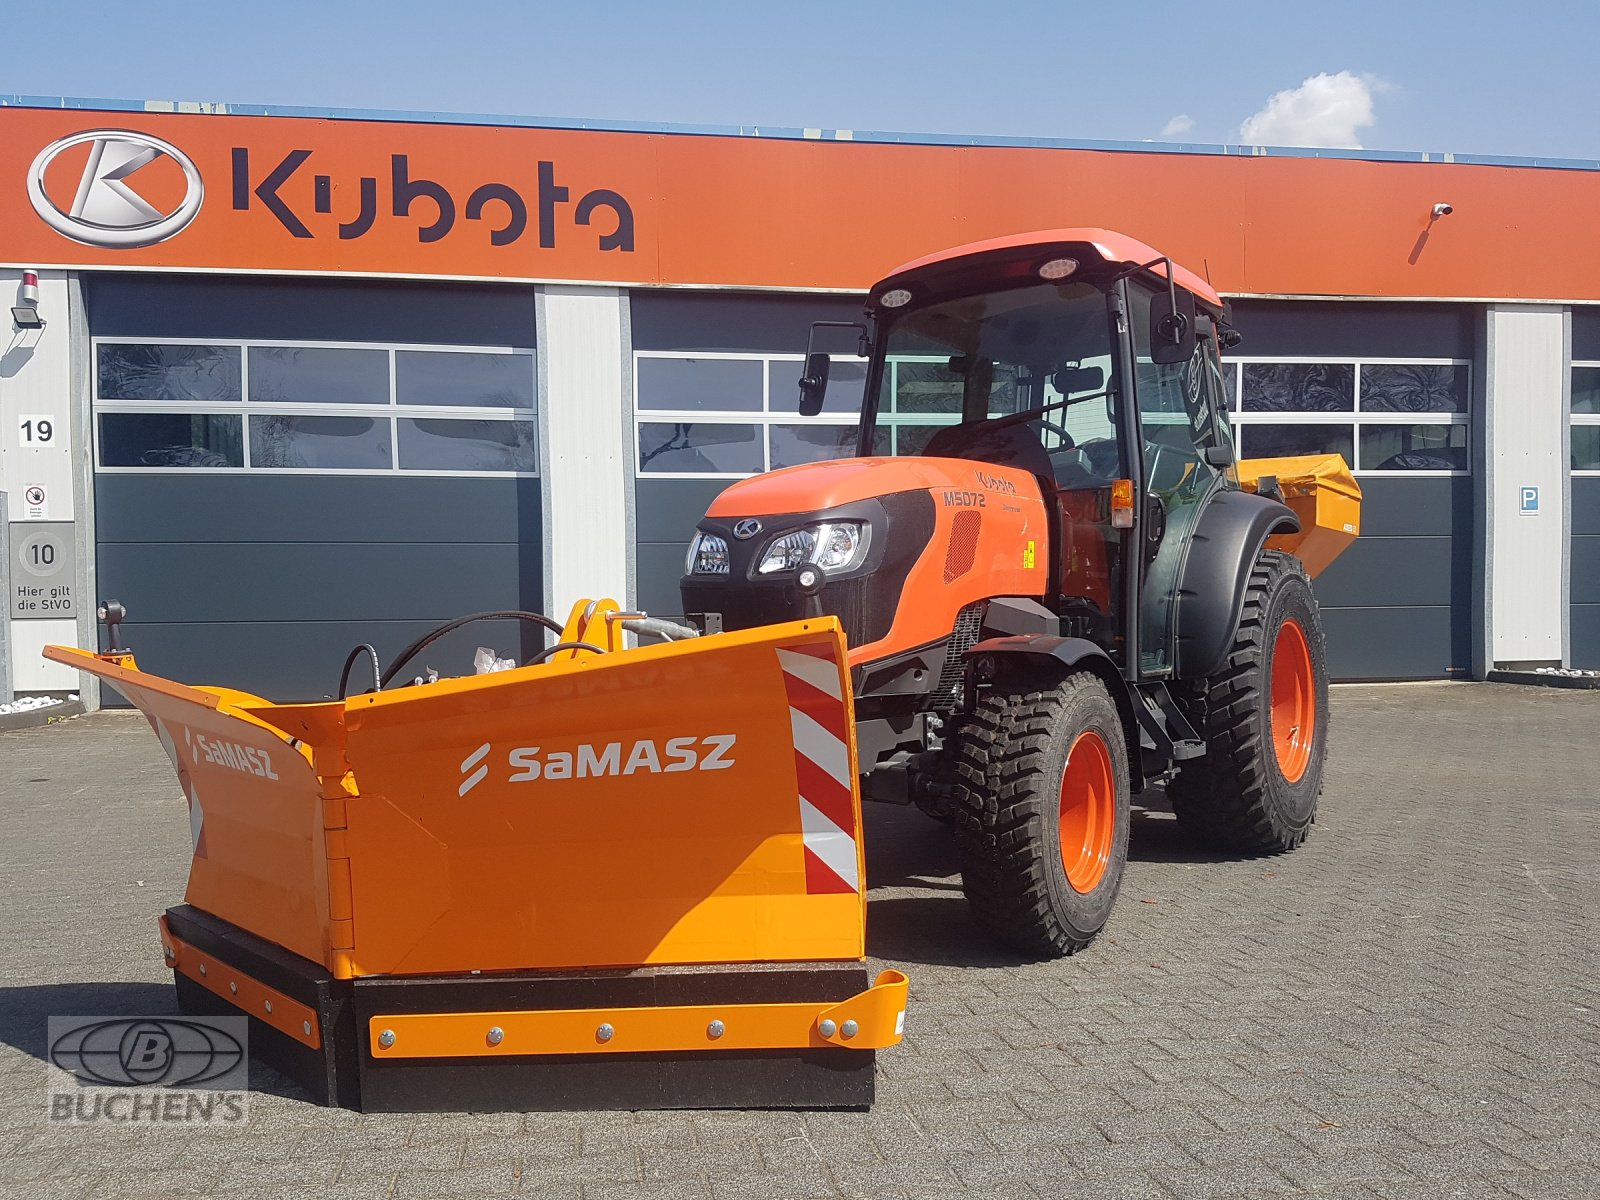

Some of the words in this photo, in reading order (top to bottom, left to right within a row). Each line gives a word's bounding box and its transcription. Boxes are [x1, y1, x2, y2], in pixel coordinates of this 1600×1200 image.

[231, 147, 635, 252] Kubota
[20, 419, 53, 442] 19
[973, 469, 1017, 494] Kubota
[943, 491, 986, 508] M5072
[1522, 489, 1537, 508] P
[31, 544, 55, 565] 10
[17, 586, 44, 597] Hier
[50, 586, 71, 600] gilt
[18, 600, 36, 610] die
[41, 600, 71, 610] StVO
[197, 733, 279, 781] SaMASZ
[508, 734, 737, 783] SaMASZ
